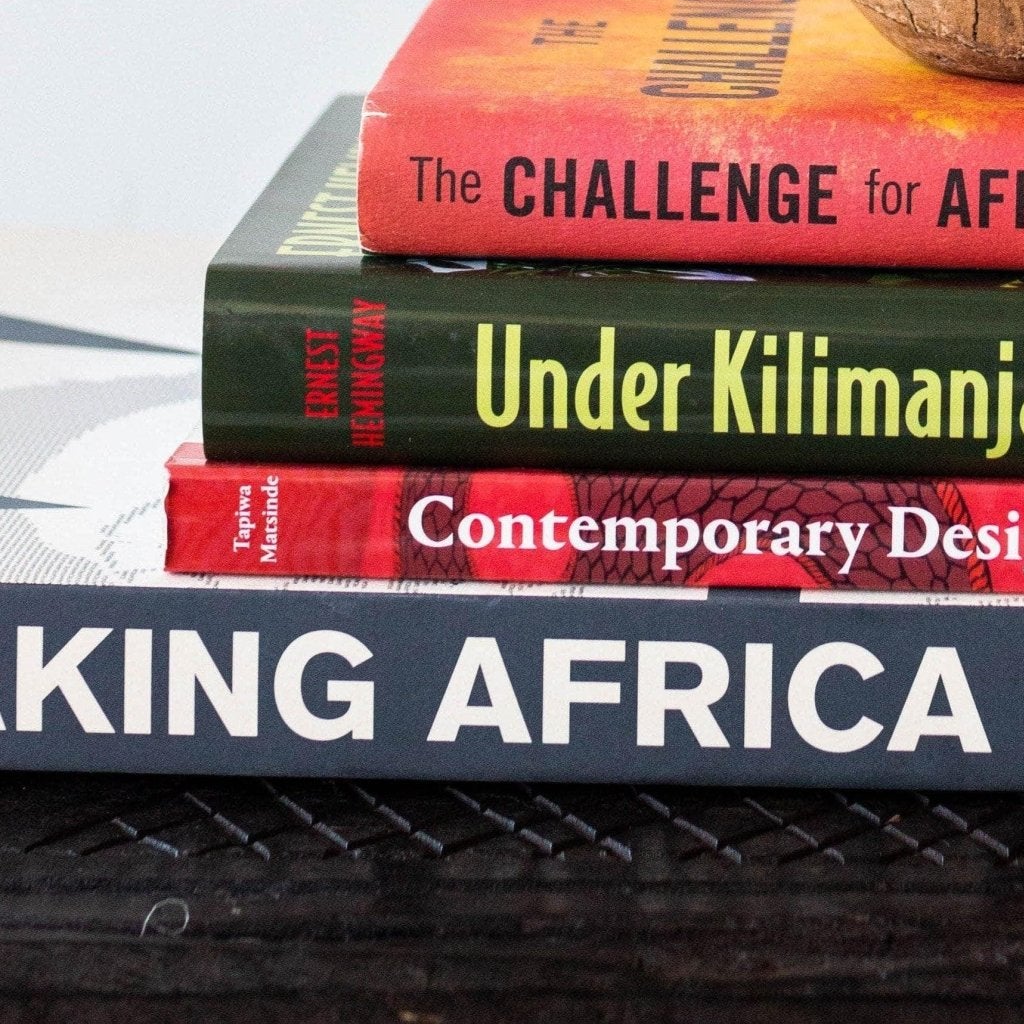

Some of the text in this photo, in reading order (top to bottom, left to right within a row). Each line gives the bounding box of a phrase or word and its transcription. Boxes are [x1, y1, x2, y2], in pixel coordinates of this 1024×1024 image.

[531, 18, 607, 45] THE
[410, 157, 482, 205] The
[504, 156, 838, 225] CHALLENGE
[864, 168, 921, 216] for
[304, 328, 340, 419] ERNEST
[350, 297, 388, 447] HEMINGWAY
[476, 323, 690, 432] Under
[233, 485, 256, 552] Tapiwa
[260, 475, 280, 563] Matsinde
[408, 495, 870, 576] Contemporary
[0, 626, 993, 754] KING AFRICA
